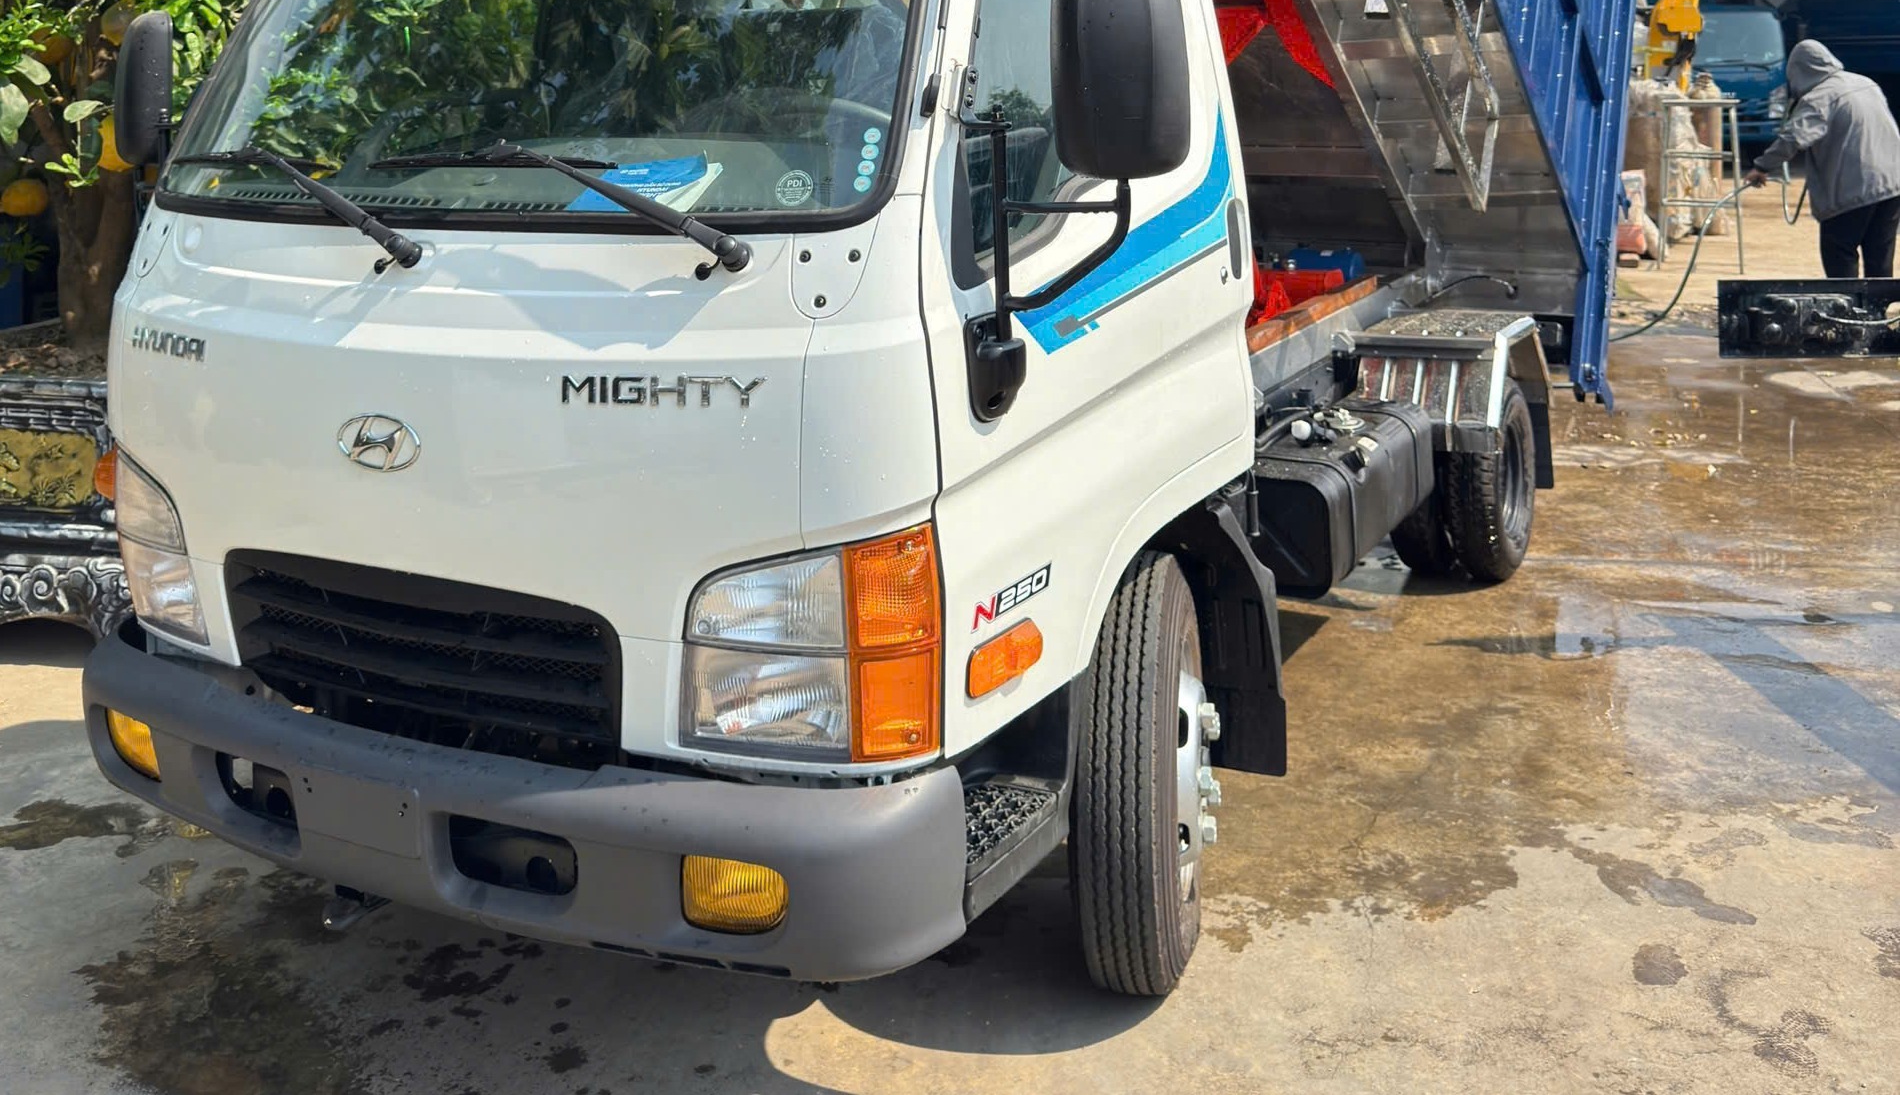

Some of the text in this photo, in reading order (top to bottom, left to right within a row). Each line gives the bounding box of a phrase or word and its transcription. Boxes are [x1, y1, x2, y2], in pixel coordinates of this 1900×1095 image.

[787, 179, 802, 187] PDI
[132, 326, 206, 362] HYUNDAI
[562, 373, 768, 408] MIGHTY
[972, 565, 1050, 631] N250
